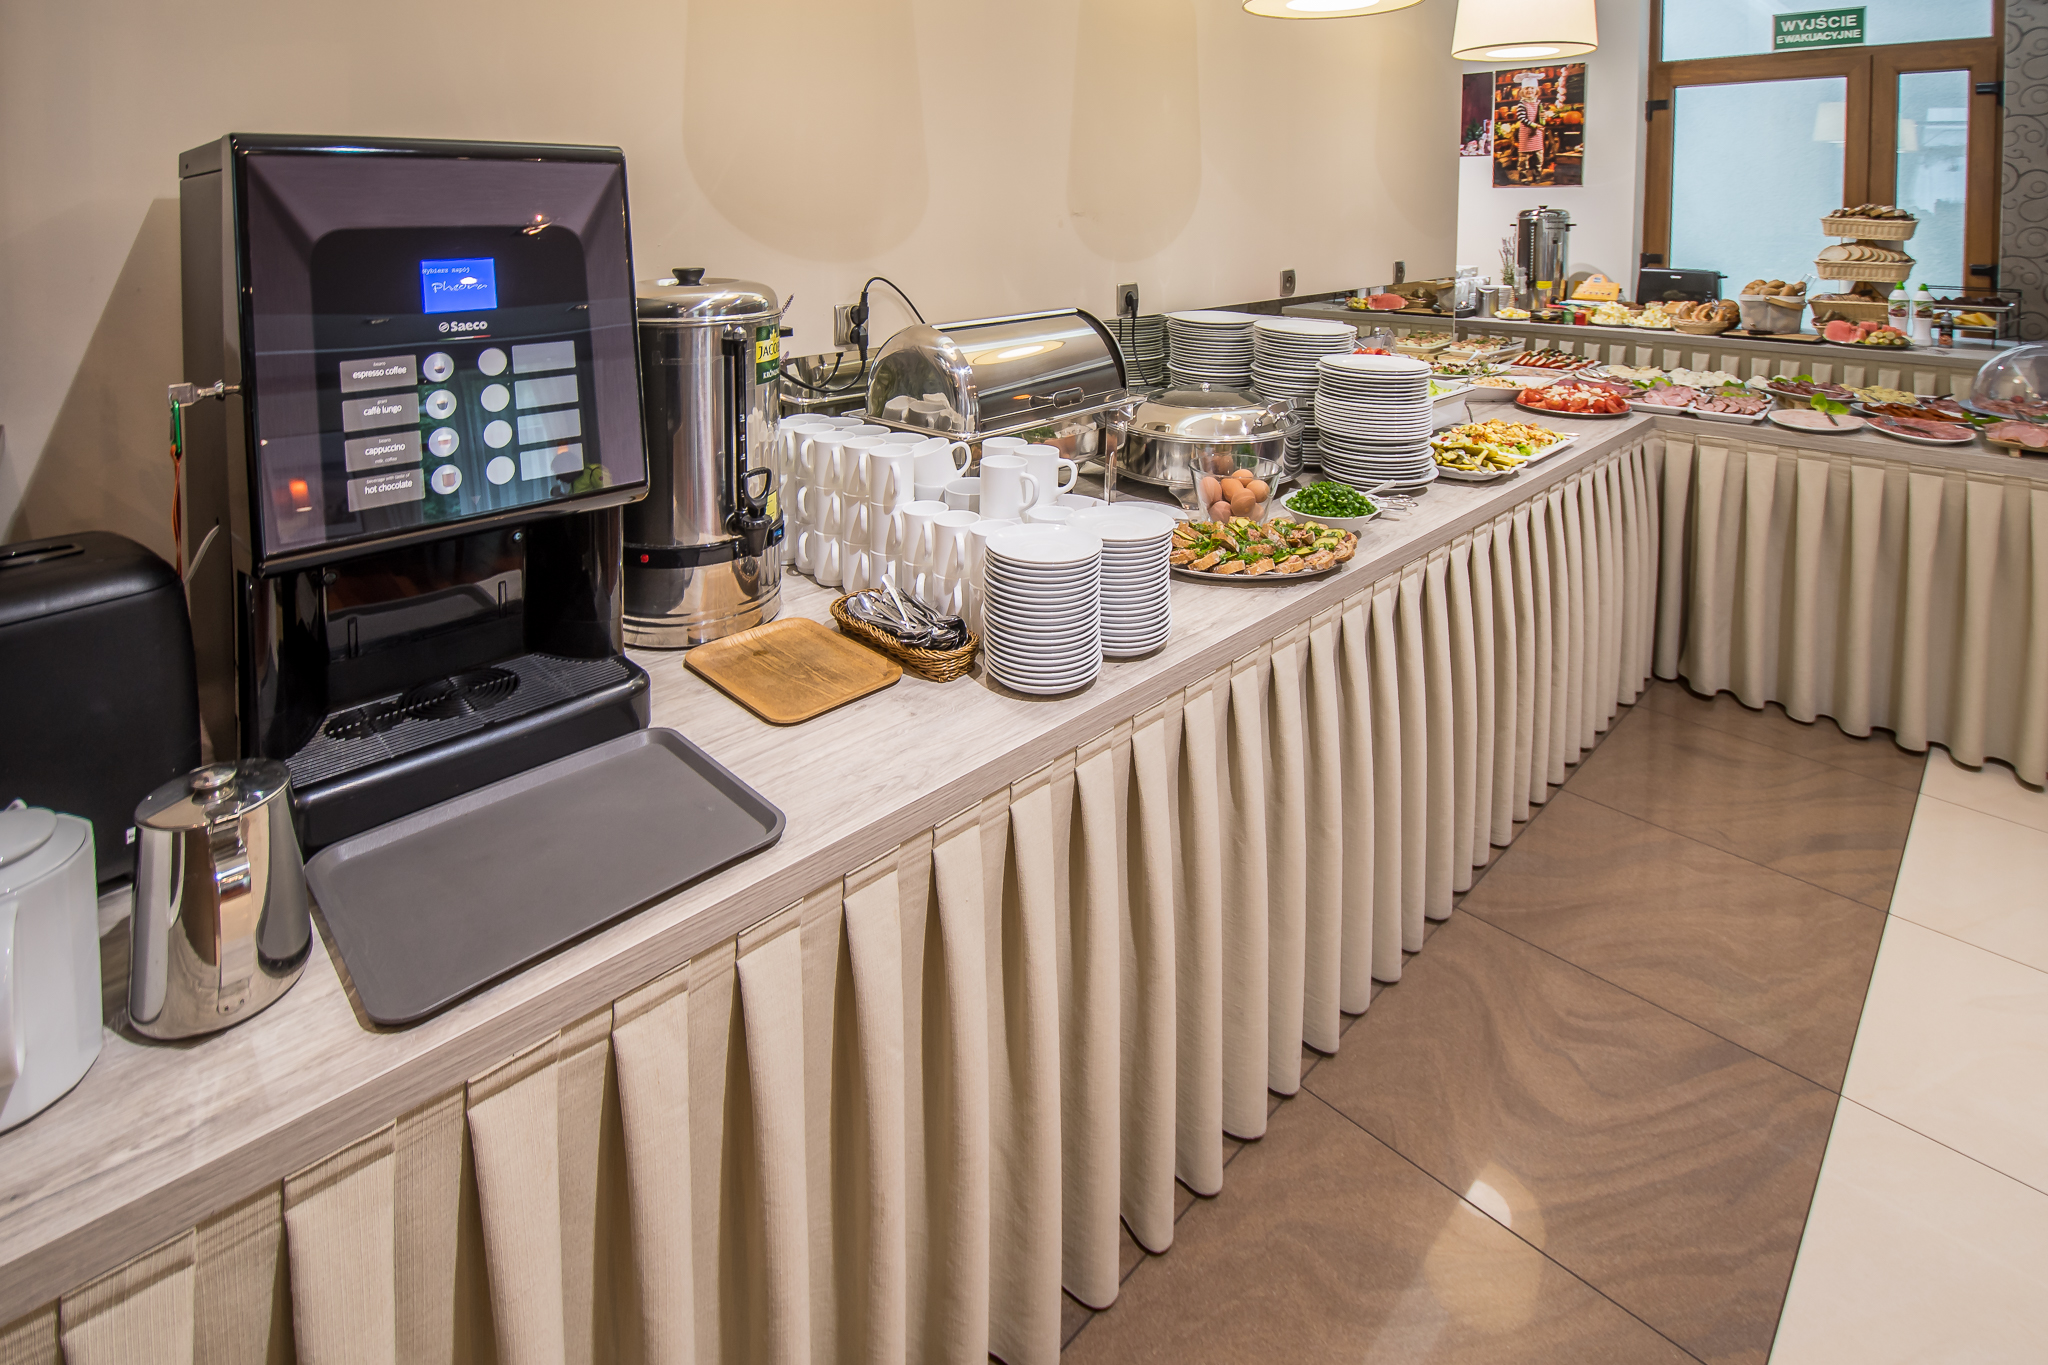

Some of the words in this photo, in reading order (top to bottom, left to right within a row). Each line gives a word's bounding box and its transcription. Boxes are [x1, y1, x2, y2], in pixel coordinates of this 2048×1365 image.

[1781, 14, 1858, 32] WYJŚCIE
[1776, 29, 1862, 44] EWAKUACYJNE
[450, 320, 488, 332] Saeco
[352, 368, 384, 380] espresso
[385, 365, 407, 376] coffee
[363, 405, 381, 416] caffè
[382, 404, 403, 414] lungo
[364, 443, 406, 456] cappuccino
[364, 485, 377, 495] hot
[378, 480, 413, 493] chocolate
